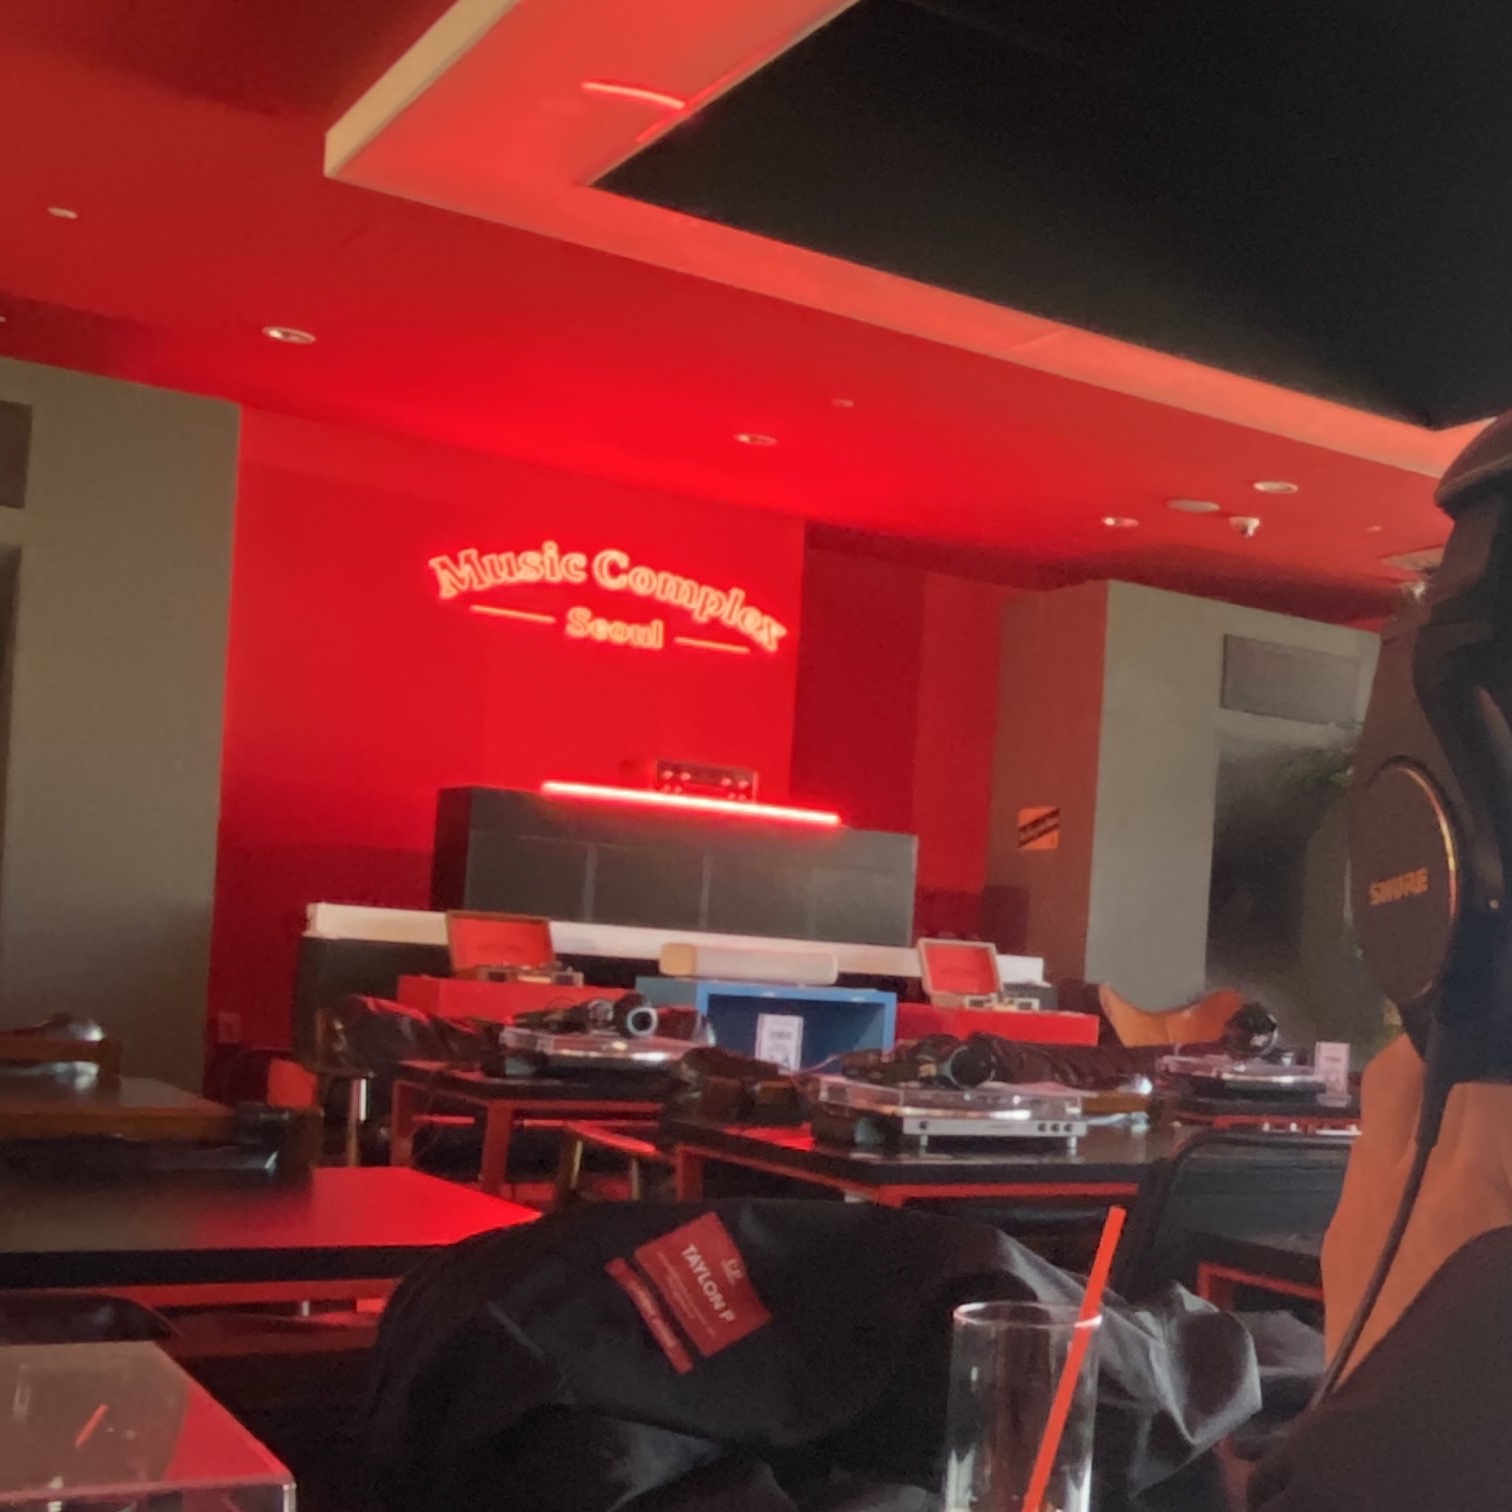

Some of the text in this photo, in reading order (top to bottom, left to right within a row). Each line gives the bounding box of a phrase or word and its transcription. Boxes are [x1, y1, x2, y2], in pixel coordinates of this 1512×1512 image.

[429, 540, 788, 652] Music Complex
[565, 607, 663, 649] Seoul
